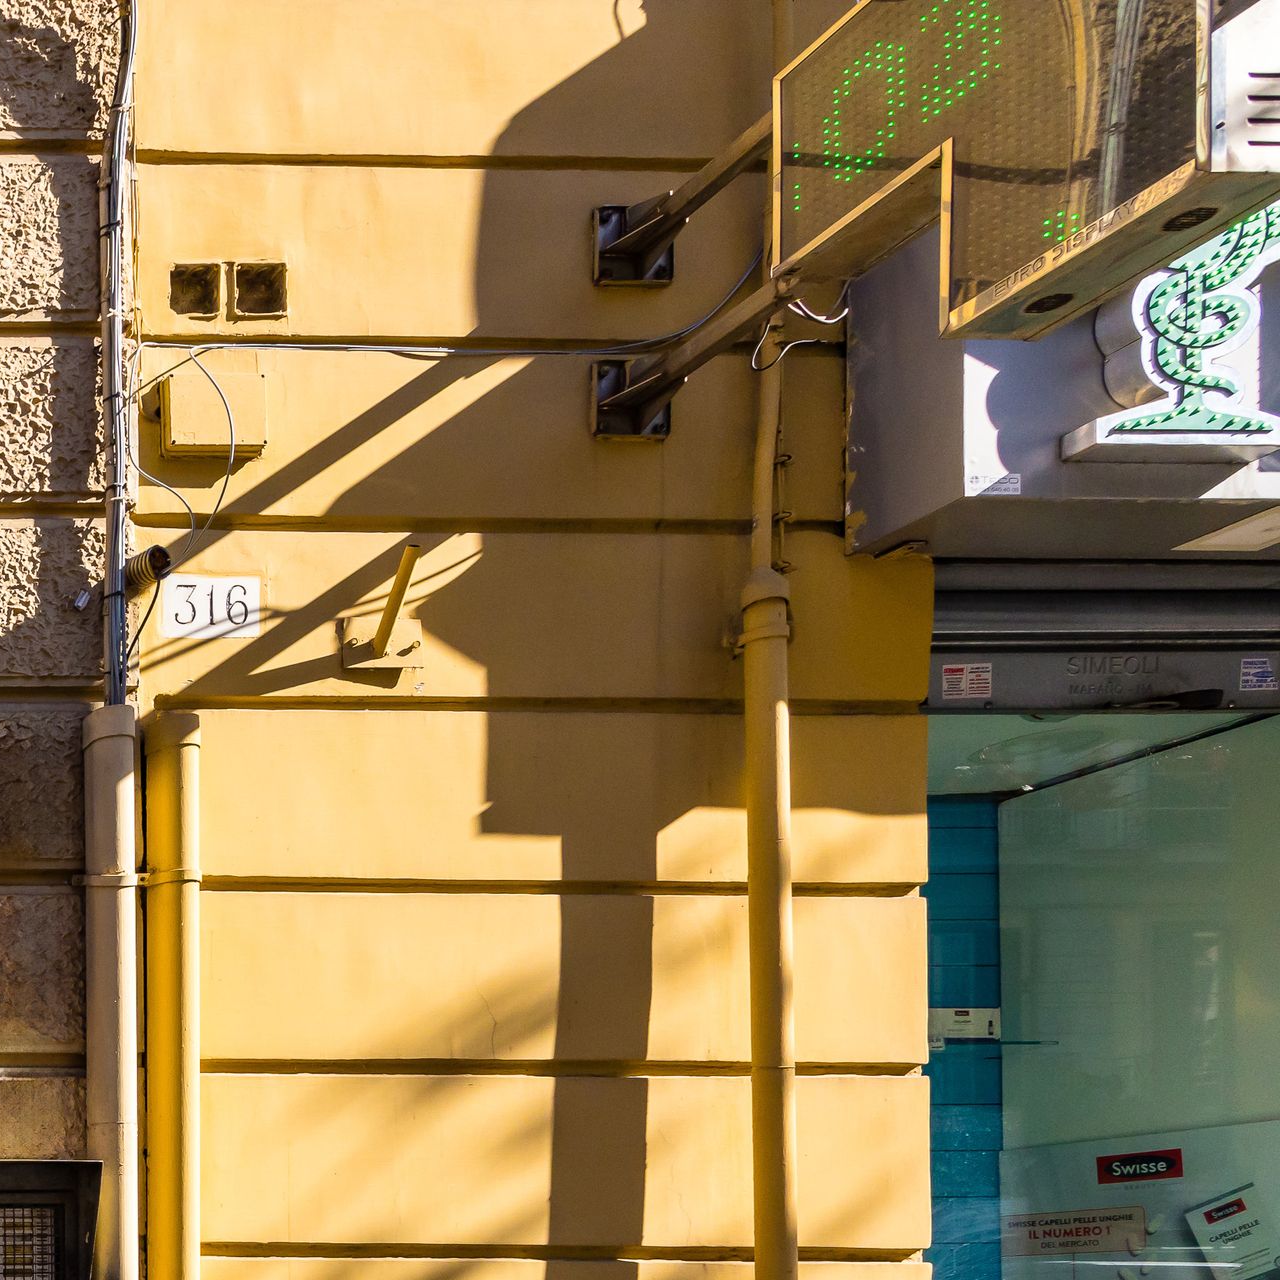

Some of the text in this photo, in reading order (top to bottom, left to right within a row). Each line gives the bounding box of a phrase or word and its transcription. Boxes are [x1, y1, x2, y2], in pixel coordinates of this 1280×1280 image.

[993, 256, 1046, 297] EURO
[174, 584, 249, 627] 316
[1066, 655, 1160, 676] SIMEOLI
[1112, 1161, 1167, 1176] Swisse
[1038, 1218, 1072, 1227] CAPELLI
[1073, 1216, 1098, 1224] PELLE
[1099, 1213, 1134, 1223] UNGHIE
[1028, 1230, 1039, 1240] IL
[1043, 1226, 1102, 1239] NUMERO
[1209, 1219, 1261, 1243] CAPELLI PELLE
[1222, 1230, 1253, 1244] UNGHIE
[1041, 1239, 1100, 1249] DEL MERCATO
